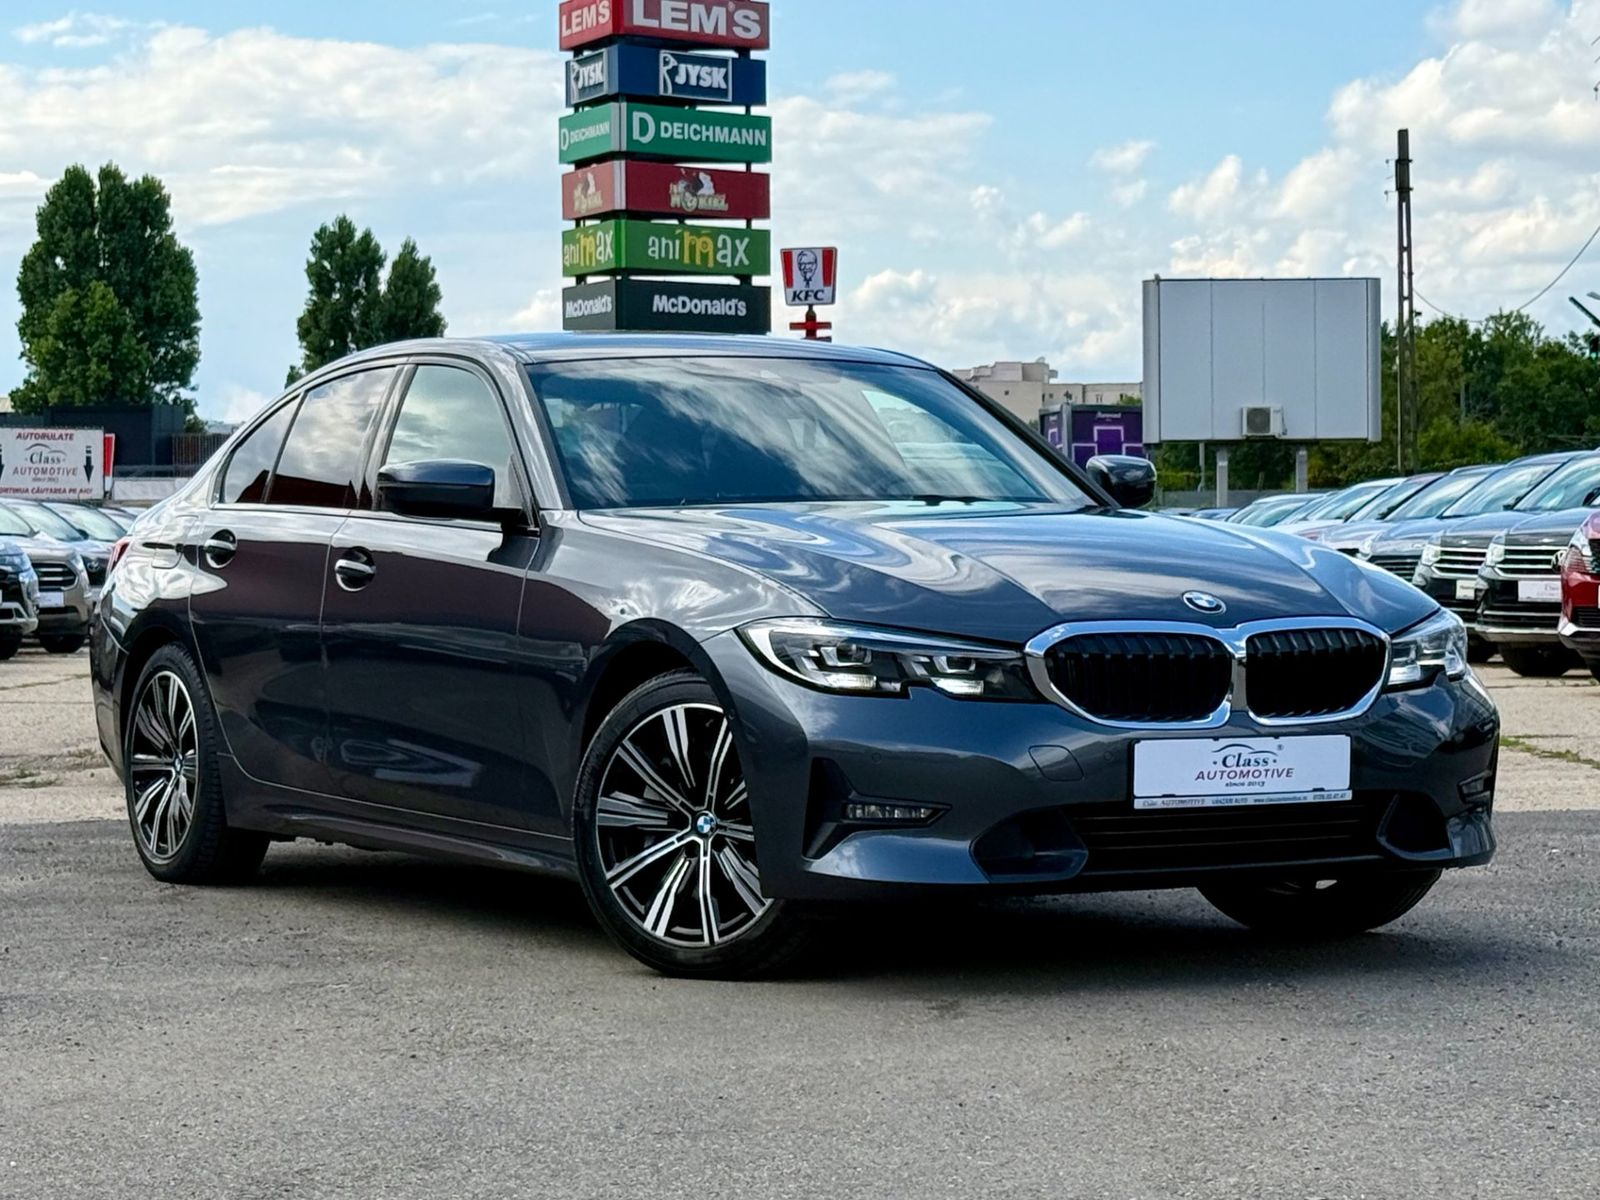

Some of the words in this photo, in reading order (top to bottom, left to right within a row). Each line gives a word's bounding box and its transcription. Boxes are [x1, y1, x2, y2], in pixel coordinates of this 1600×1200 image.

[562, 0, 611, 37] LEM'S
[633, 0, 762, 39] LEM'S
[577, 60, 605, 90] JYSK
[674, 62, 727, 90] JYSK
[570, 120, 610, 145] DEICHMANN
[659, 120, 767, 147] DEICHMANN
[563, 228, 614, 267] animax
[647, 228, 750, 268] animax
[565, 294, 612, 318] McDonald's
[652, 294, 747, 317] McDonald's
[791, 288, 825, 302] KFC
[30, 451, 61, 465] Class
[12, 466, 79, 476] AUTOMOTIVE
[1221, 752, 1270, 769] Class
[1194, 767, 1295, 782] AUTOMOTIVE
